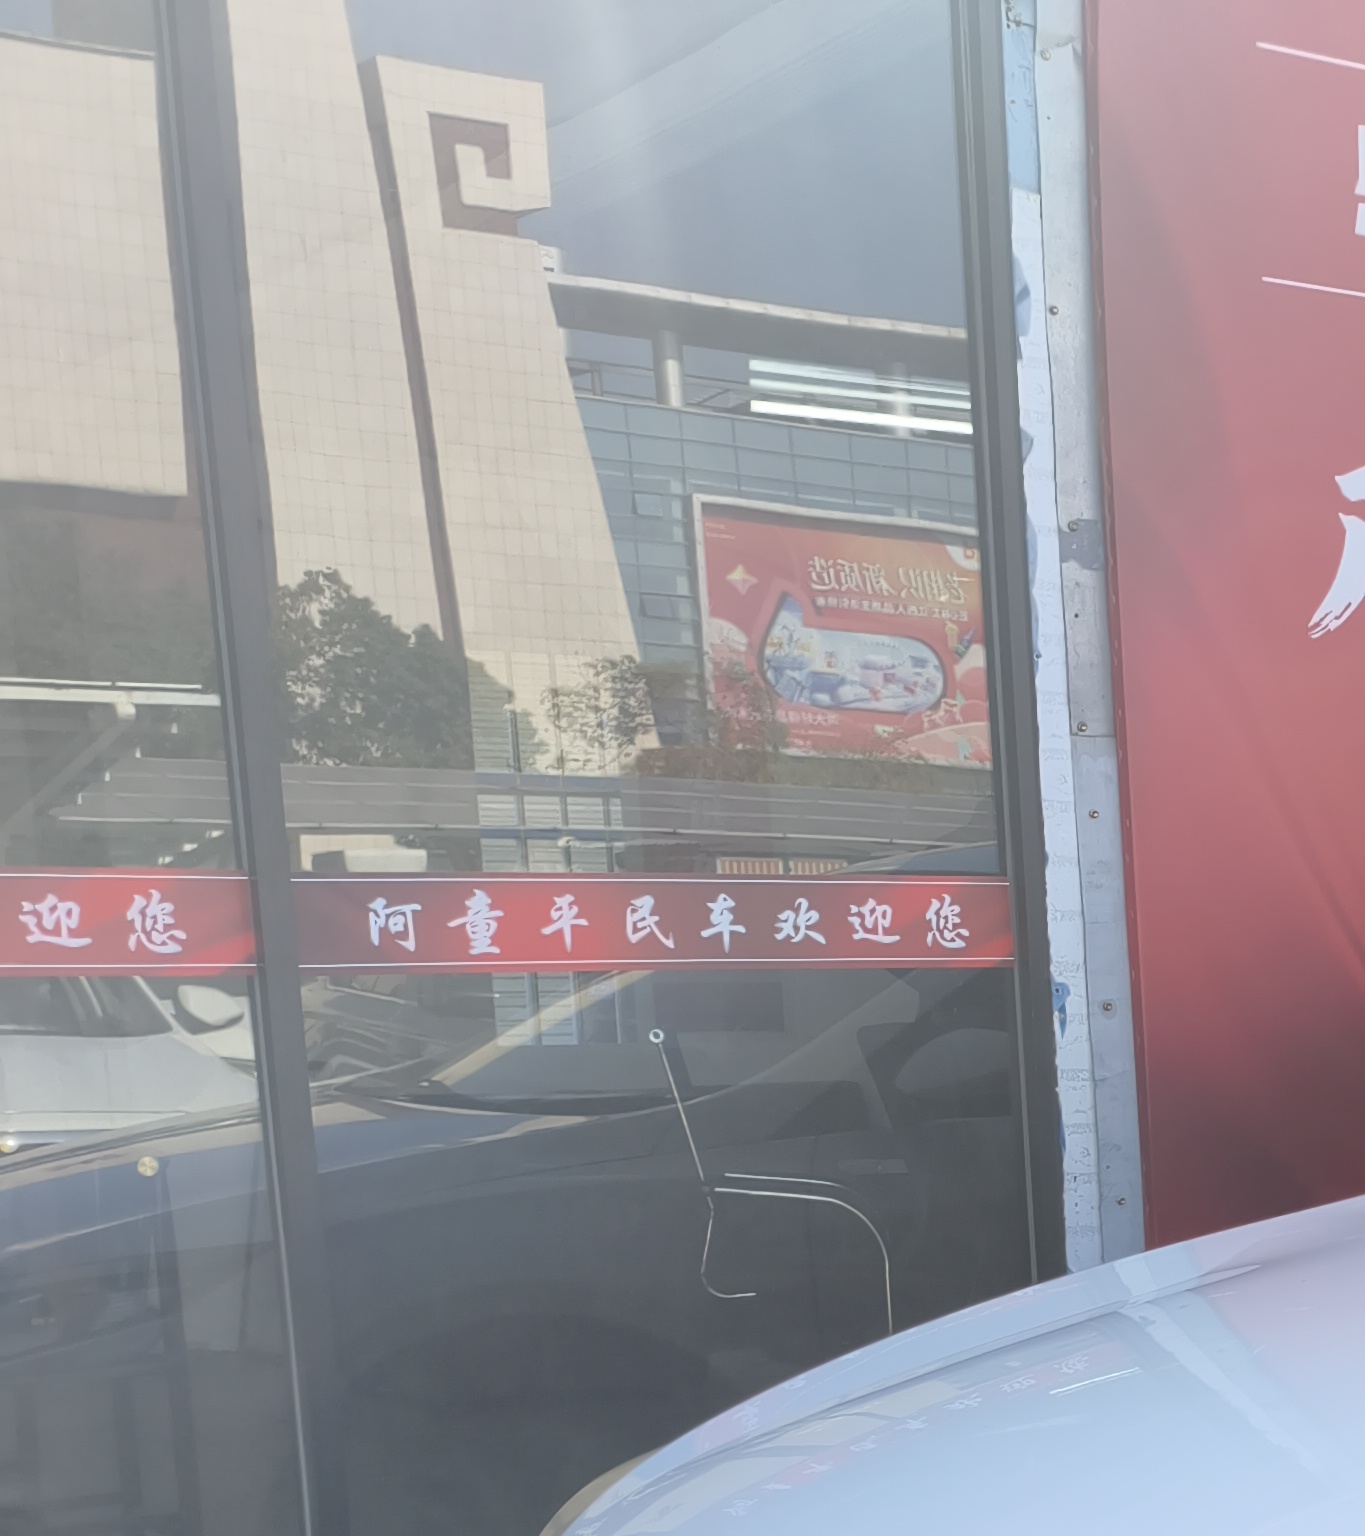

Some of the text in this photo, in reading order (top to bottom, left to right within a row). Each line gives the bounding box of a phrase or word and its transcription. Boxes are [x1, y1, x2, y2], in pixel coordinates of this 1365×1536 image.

[18, 888, 188, 954] 迎您
[367, 888, 970, 956] 阿童平民车欢迎您
